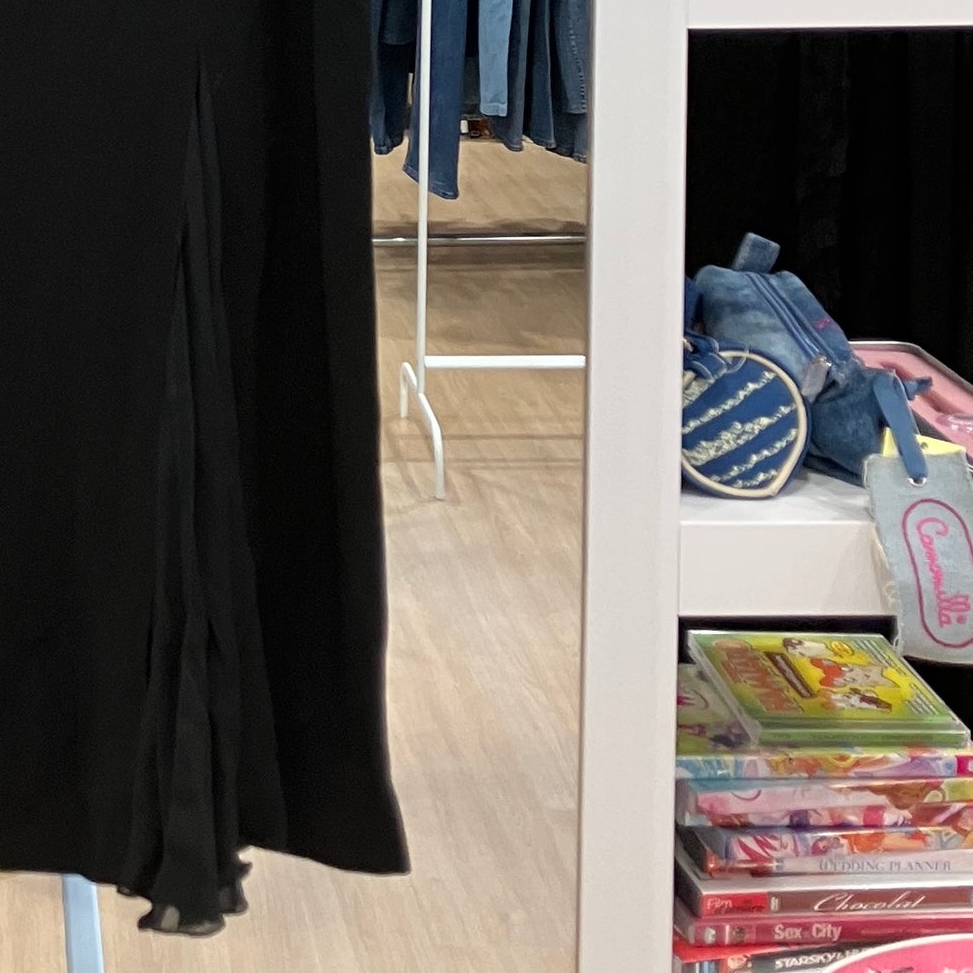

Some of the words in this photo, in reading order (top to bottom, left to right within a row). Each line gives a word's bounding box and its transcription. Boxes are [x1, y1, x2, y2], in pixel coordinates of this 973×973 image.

[819, 857, 883, 872] WEDDING
[889, 860, 952, 872] PLANNER
[813, 890, 926, 911] Chocolat
[774, 923, 803, 940] Sex
[812, 923, 843, 941] City
[774, 952, 836, 970] STARSKY
